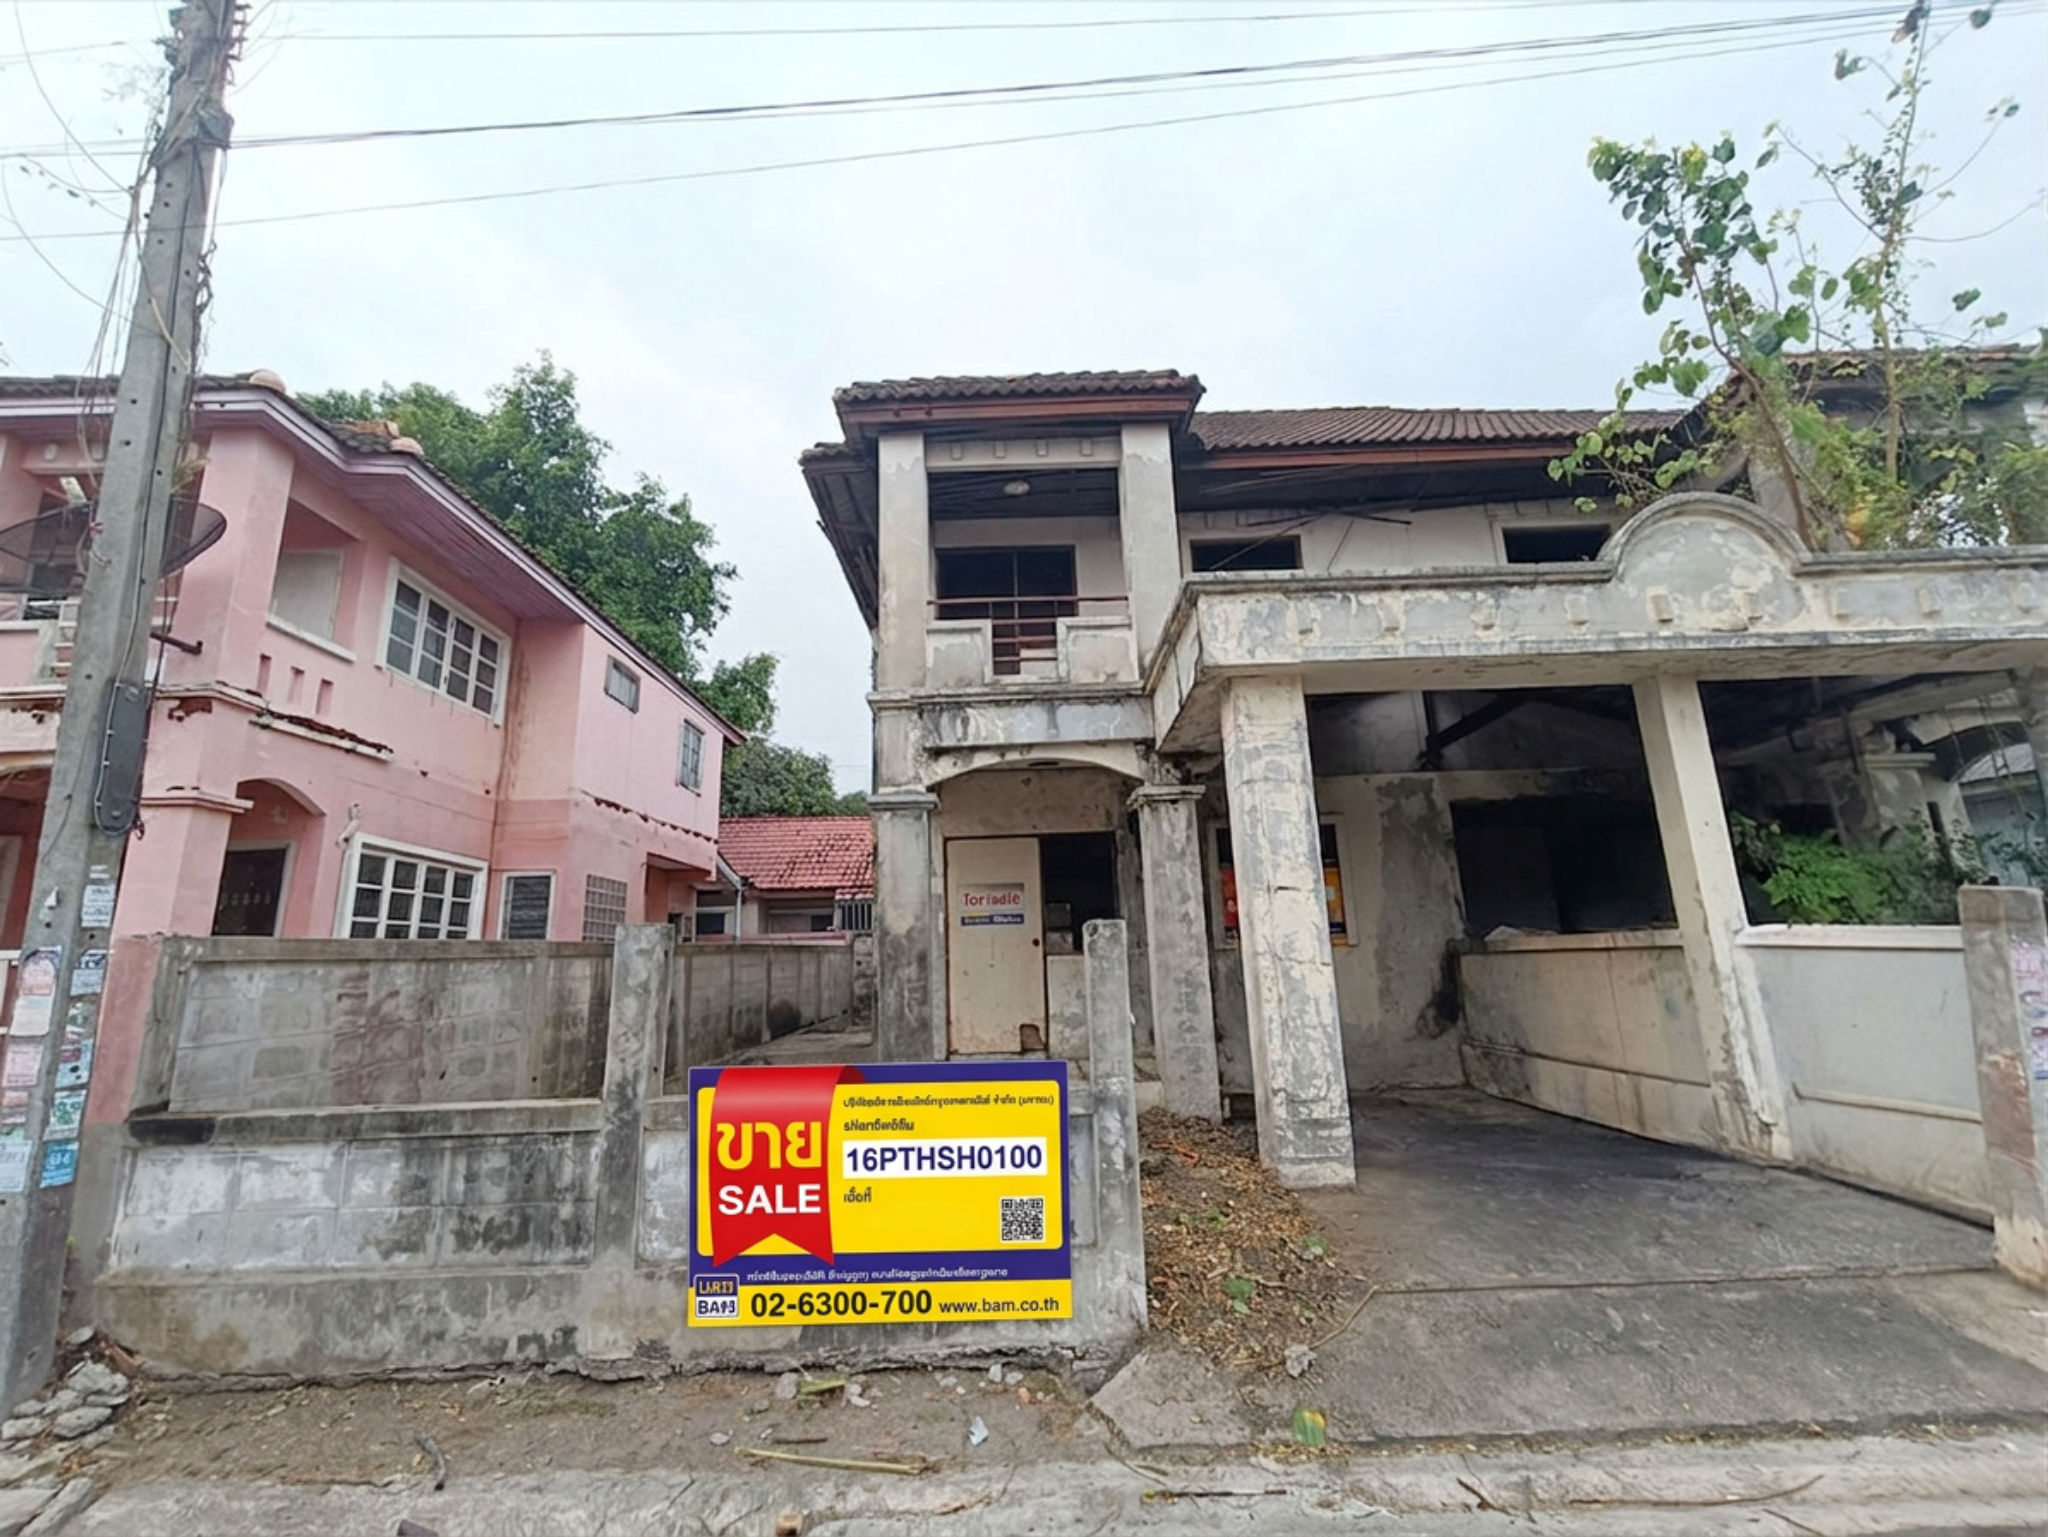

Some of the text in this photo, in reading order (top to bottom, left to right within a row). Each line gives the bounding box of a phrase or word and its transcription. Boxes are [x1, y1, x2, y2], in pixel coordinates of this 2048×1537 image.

[716, 1121, 822, 1170] ขาย
[847, 1144, 1042, 1172] 16PTHSH0100
[718, 1183, 821, 1215] SALE
[751, 1290, 1059, 1317] 02-6300-700 www.bam.co.th
